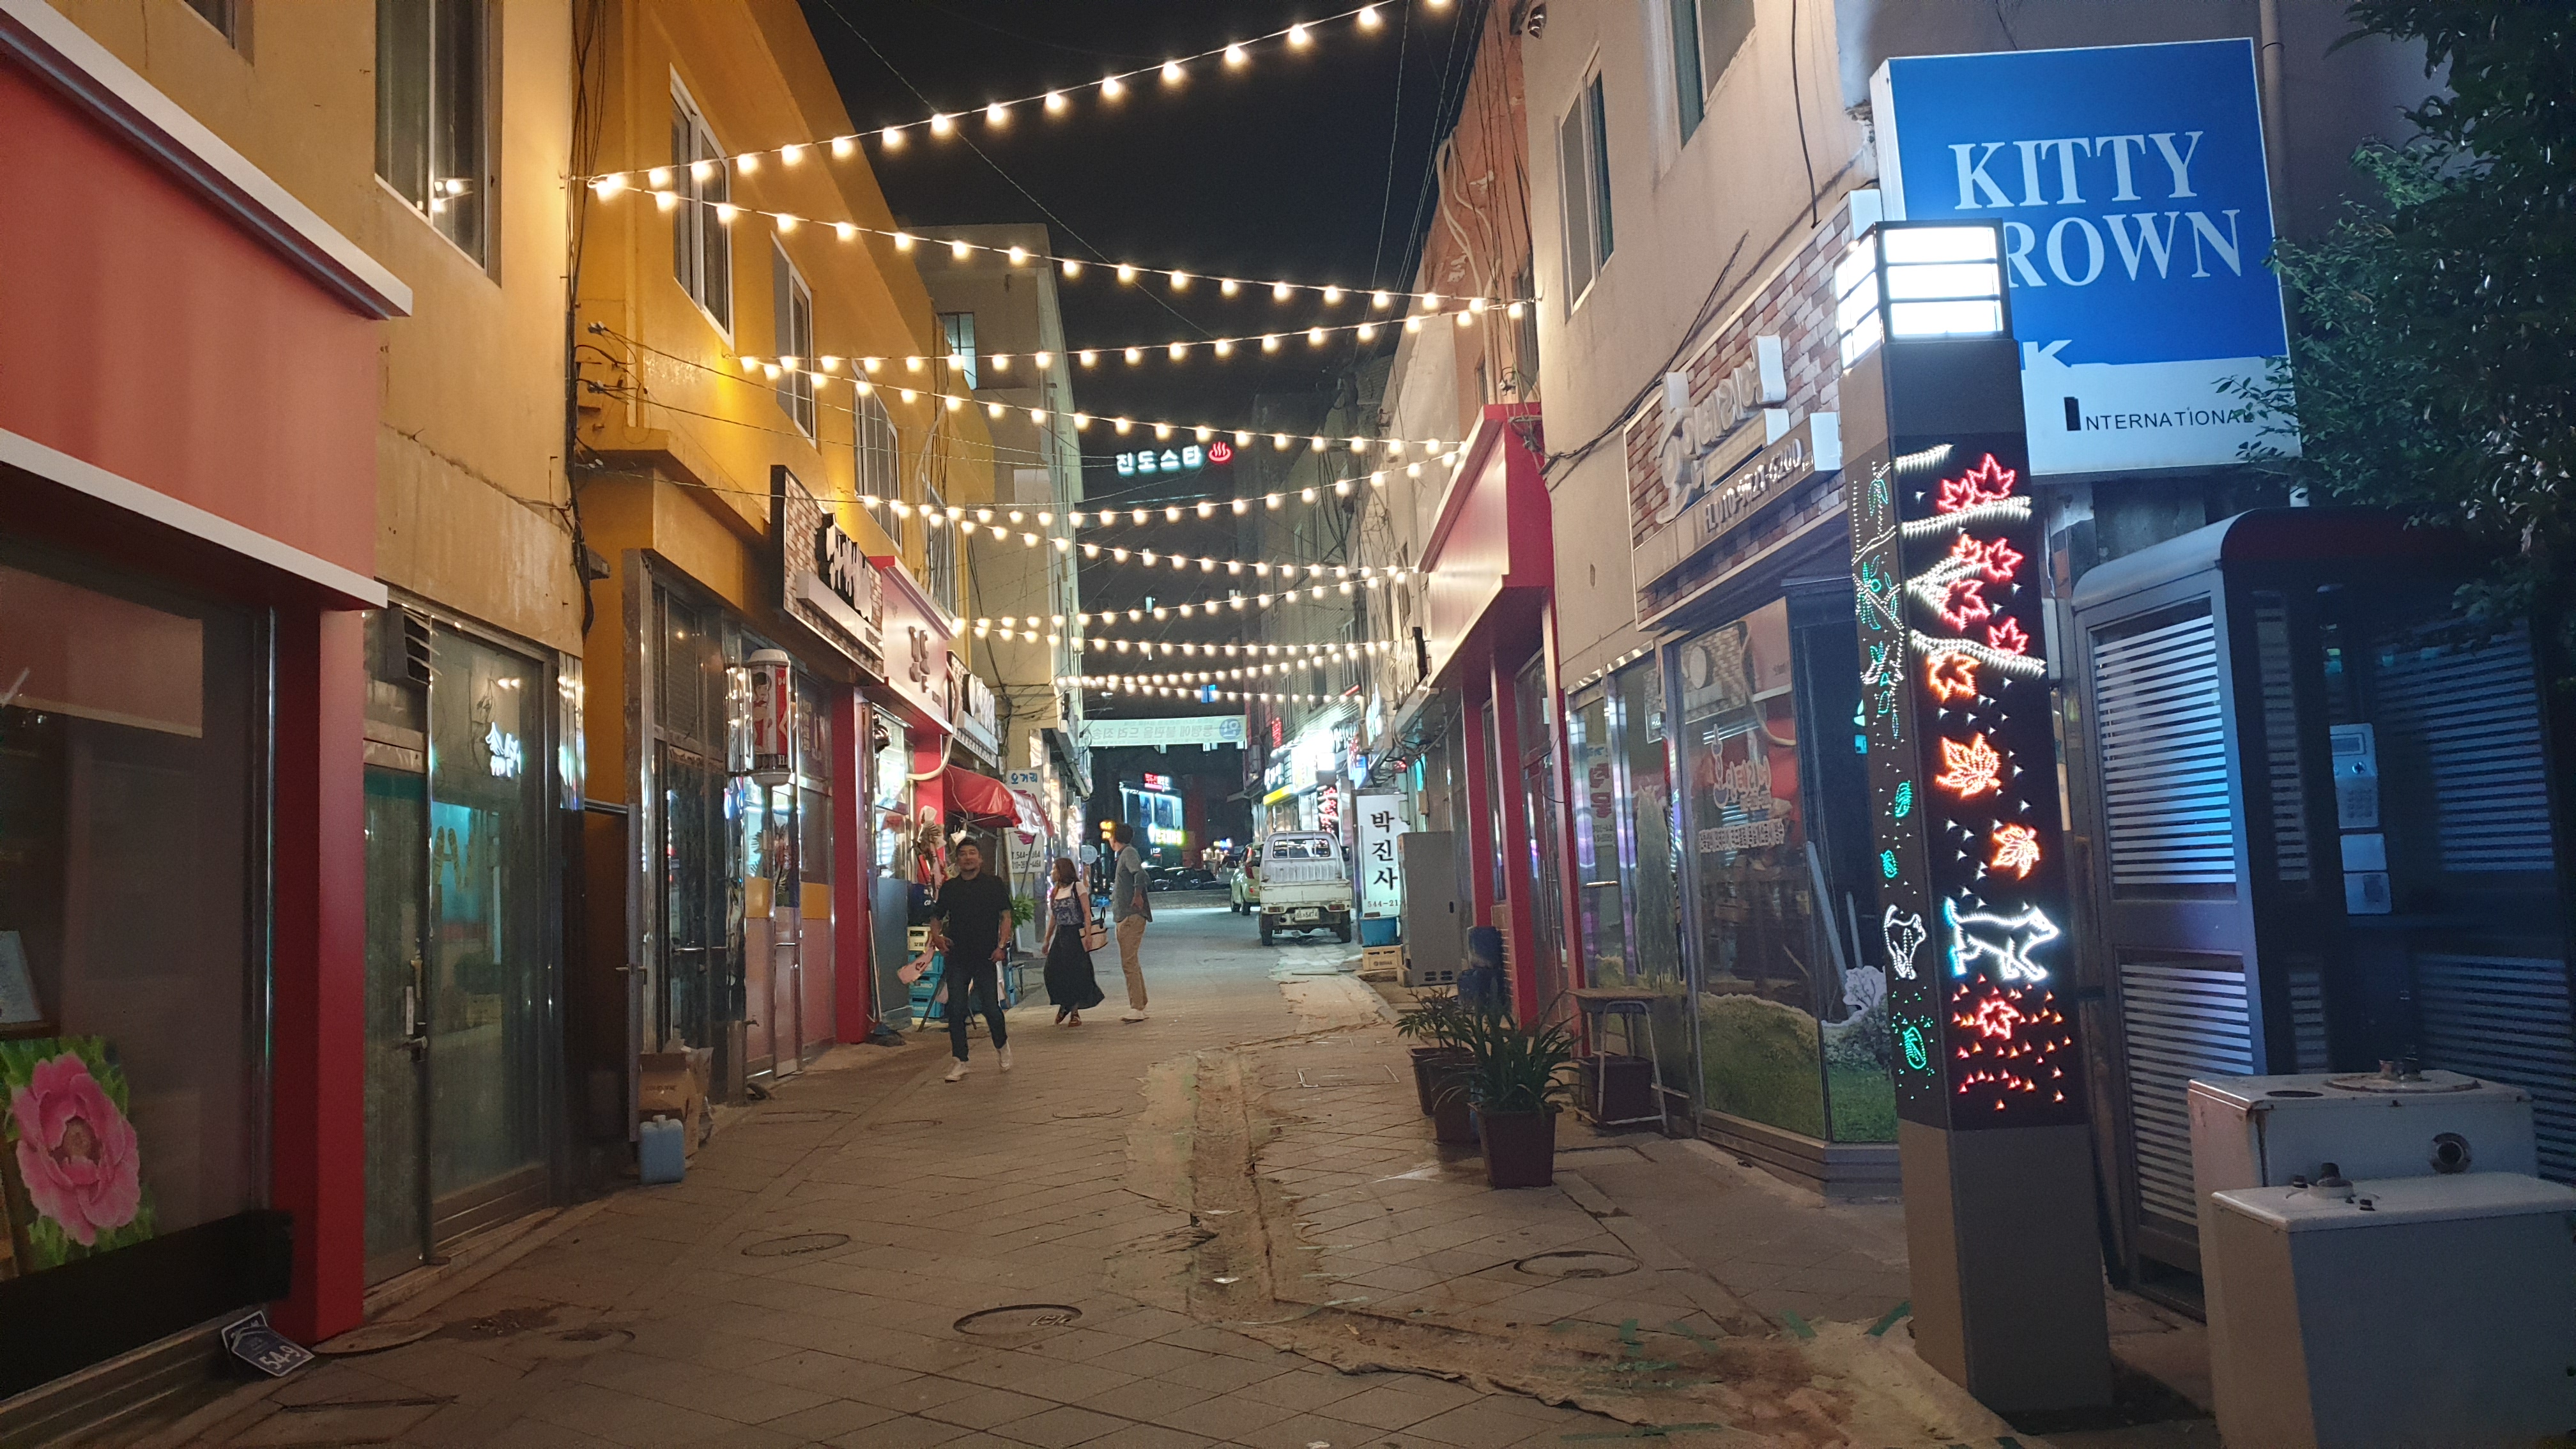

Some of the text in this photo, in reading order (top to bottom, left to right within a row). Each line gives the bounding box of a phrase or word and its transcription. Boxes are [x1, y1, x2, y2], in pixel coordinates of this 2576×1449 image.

[1948, 131, 2204, 210] KITTY
[2003, 209, 2241, 288] ROWN
[1116, 445, 1202, 475] 진도스타
[1370, 811, 1398, 891] 박진사
[1367, 900, 1399, 908] 544-21
